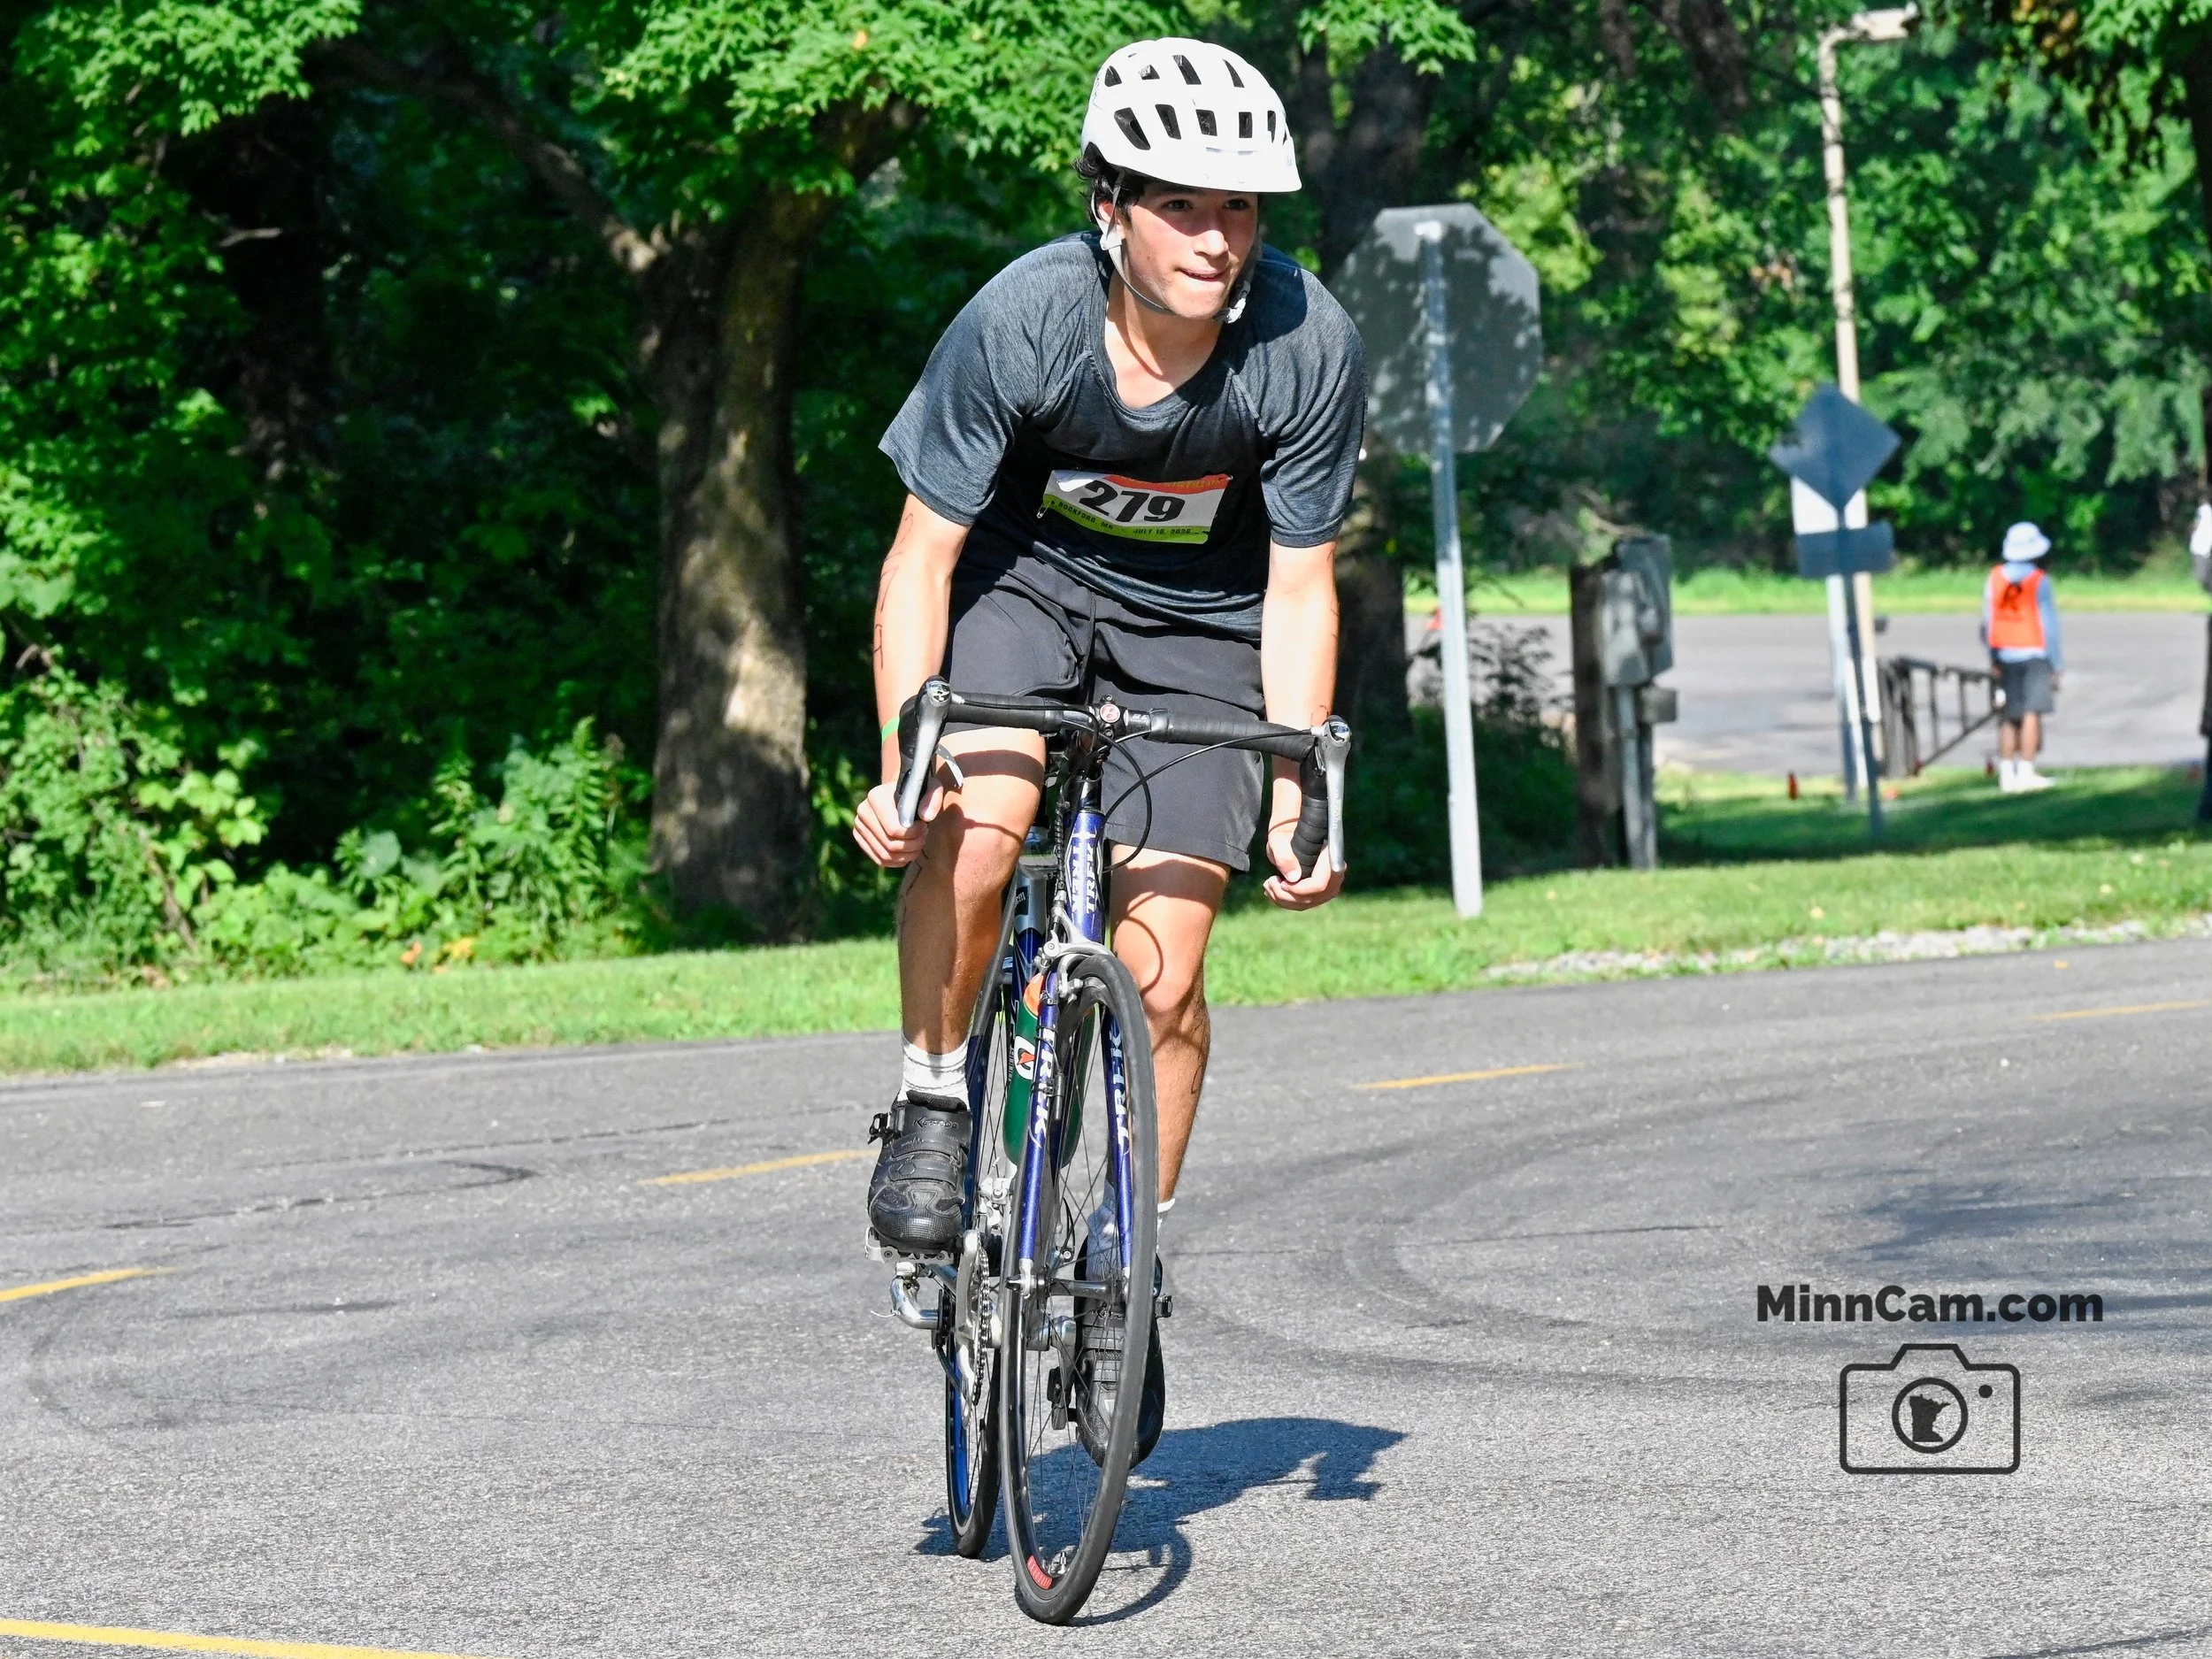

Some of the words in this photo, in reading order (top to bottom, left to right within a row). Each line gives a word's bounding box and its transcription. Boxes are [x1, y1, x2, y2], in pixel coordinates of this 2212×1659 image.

[1079, 480, 1185, 522] 279
[1086, 842, 1095, 914] TREK
[1034, 1028, 1056, 1139] TREK
[1110, 1030, 1129, 1147] TREK
